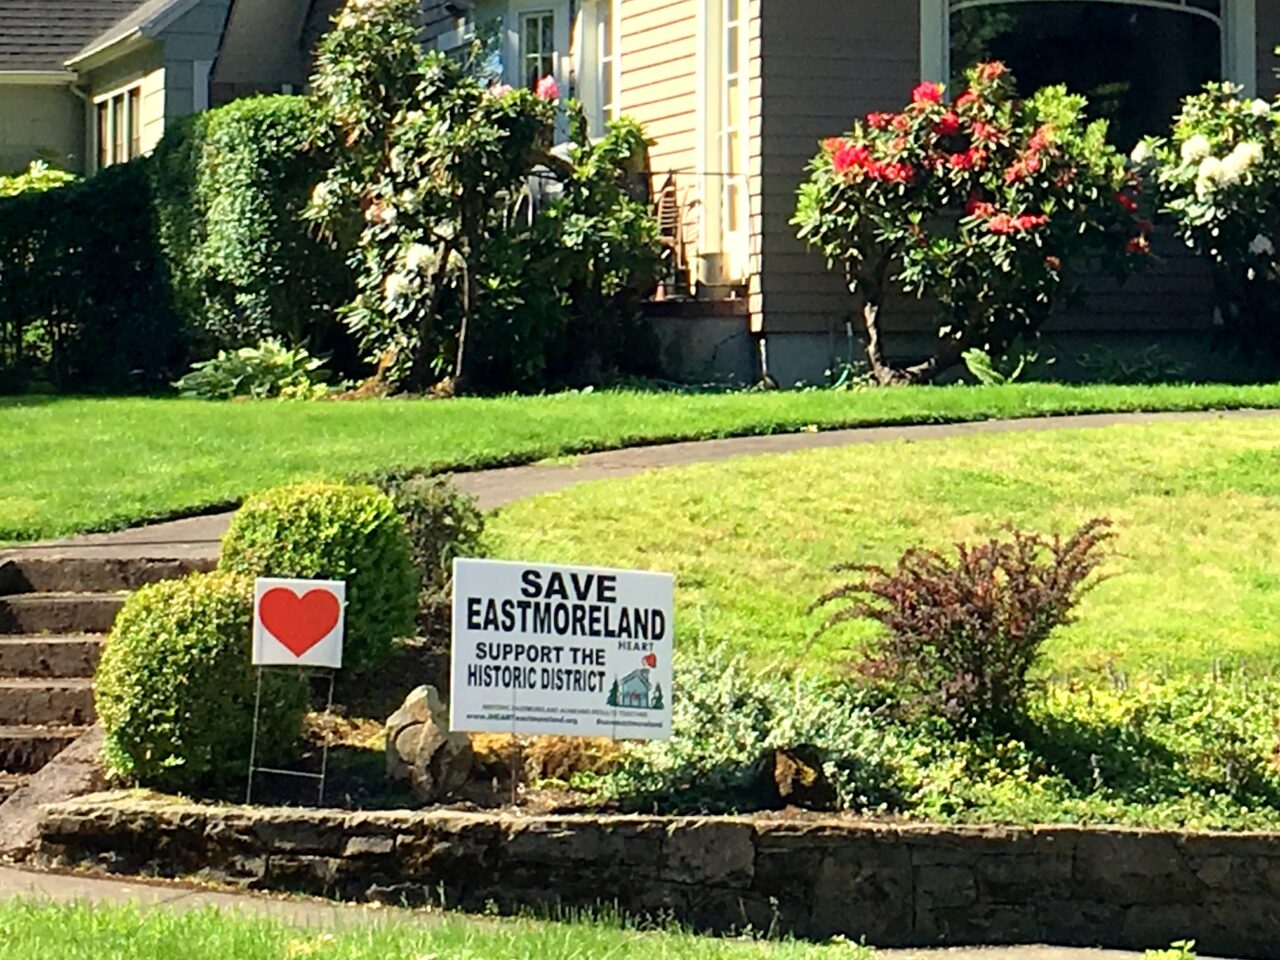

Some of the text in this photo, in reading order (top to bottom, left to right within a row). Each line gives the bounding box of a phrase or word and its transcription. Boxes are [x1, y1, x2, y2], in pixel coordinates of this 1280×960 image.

[520, 569, 617, 603] SAVE
[467, 597, 666, 641] EASTMORELAND
[475, 642, 606, 666] SUPPORT THE
[618, 640, 654, 652] HEART
[468, 664, 606, 693] HISTORIC DISTRICT
